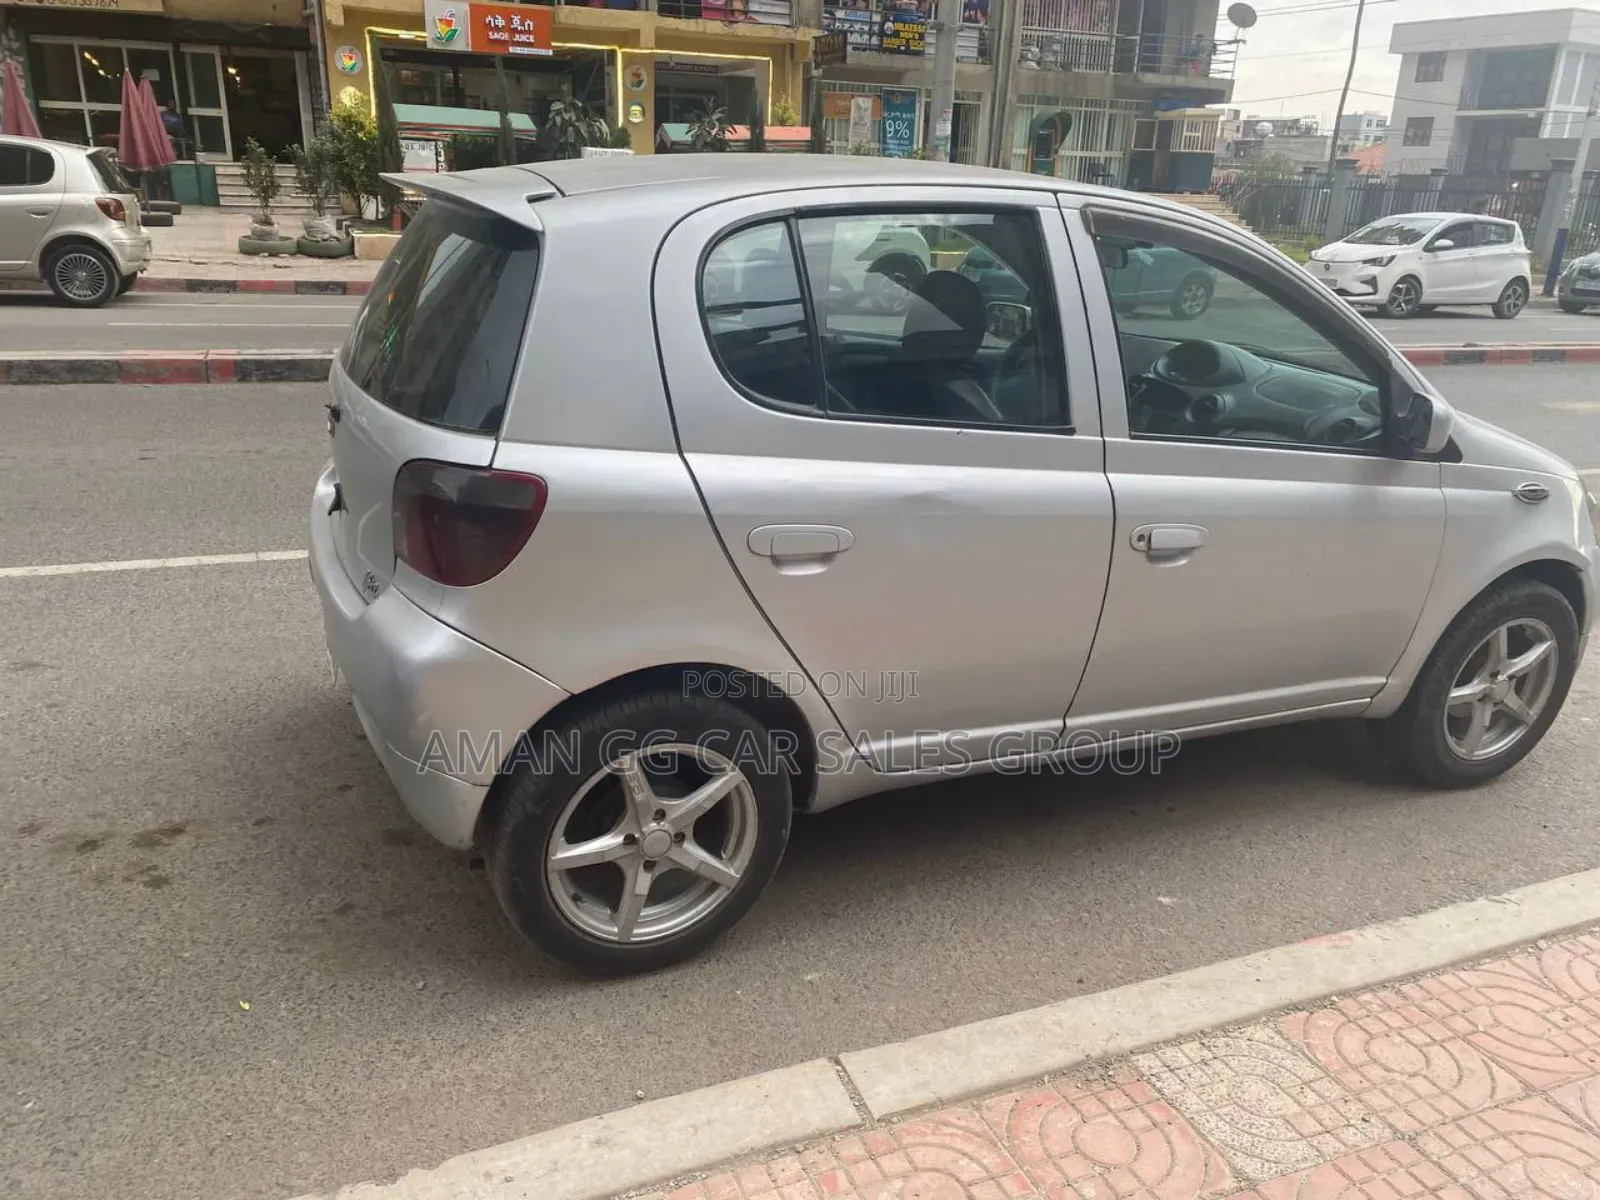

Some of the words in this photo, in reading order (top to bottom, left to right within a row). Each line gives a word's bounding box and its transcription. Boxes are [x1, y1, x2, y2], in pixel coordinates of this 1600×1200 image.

[488, 31, 510, 41] SAQE
[512, 33, 536, 43] JUICE
[885, 119, 910, 139] 9%
